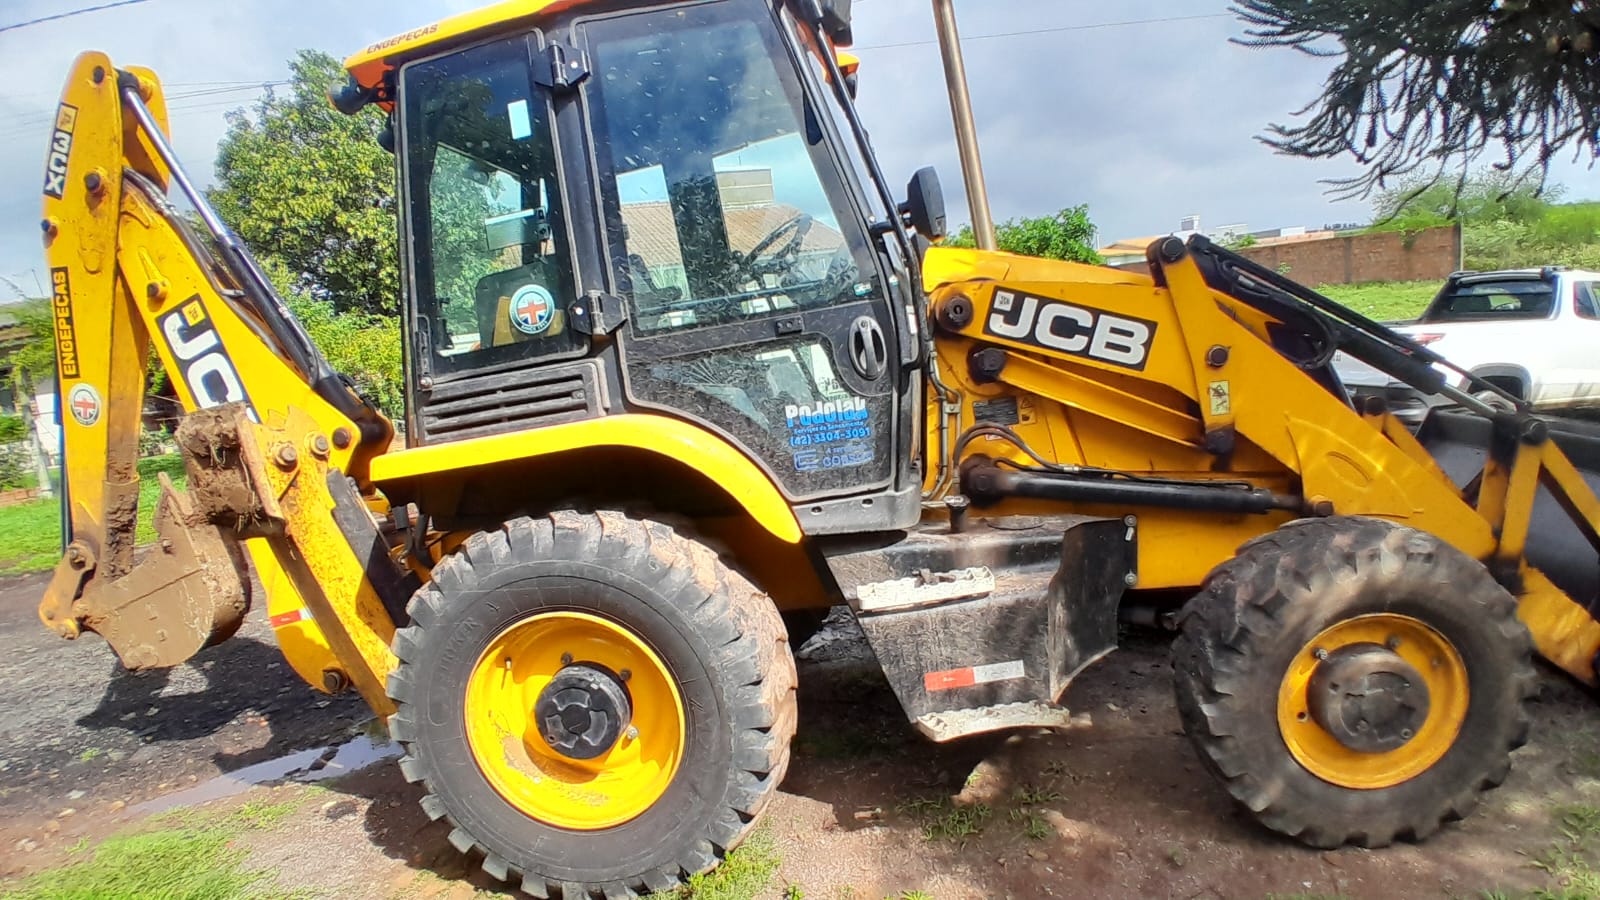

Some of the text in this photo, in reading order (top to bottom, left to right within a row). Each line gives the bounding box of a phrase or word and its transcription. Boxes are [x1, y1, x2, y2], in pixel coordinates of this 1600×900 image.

[45, 131, 71, 194] 3CX
[989, 293, 1149, 365] JCB
[164, 310, 258, 423] JC
[784, 396, 869, 428] Podolak
[790, 427, 871, 447] (42) 3304-3091
